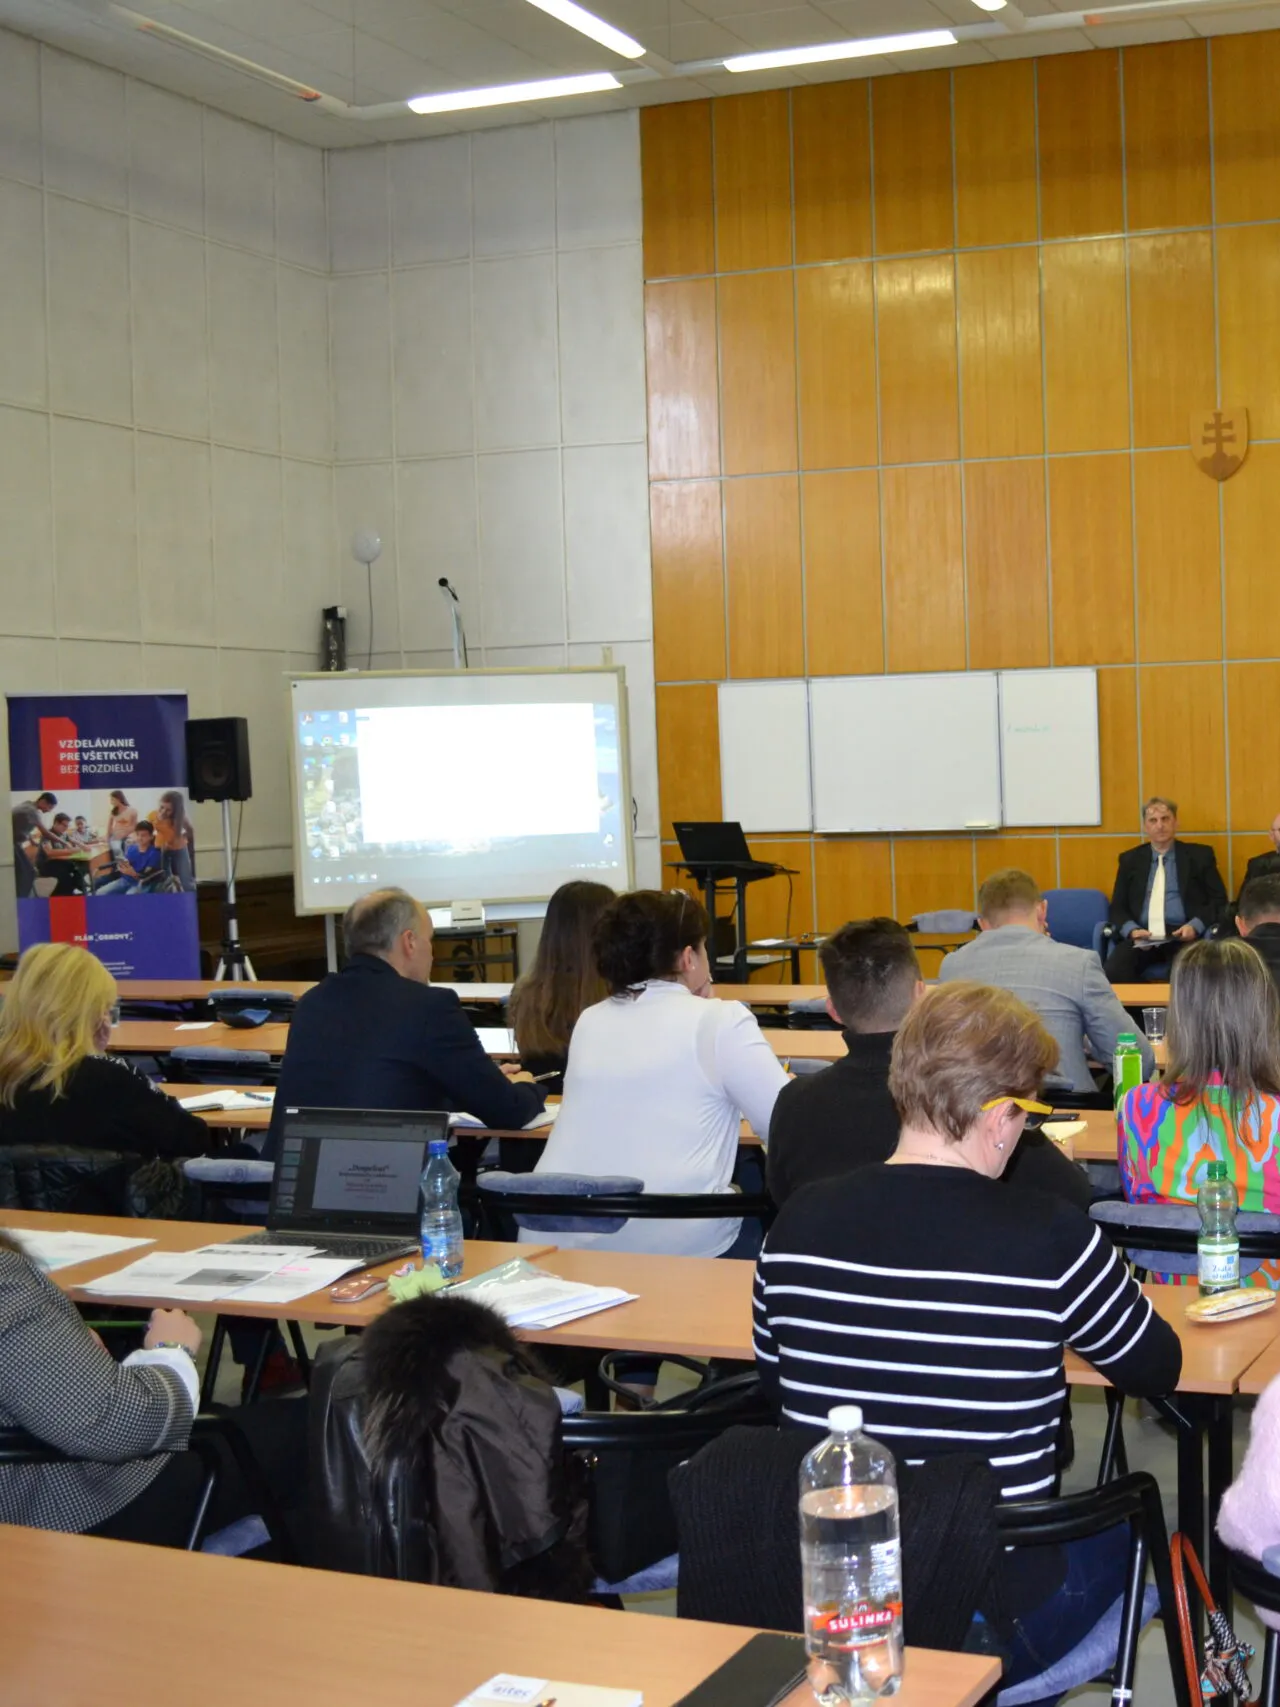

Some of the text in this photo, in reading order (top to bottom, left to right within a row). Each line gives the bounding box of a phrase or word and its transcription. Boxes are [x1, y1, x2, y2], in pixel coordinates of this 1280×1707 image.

[59, 738, 135, 748] VZDELÁVANIE
[60, 750, 139, 761] PRE VŠETKÝCH
[60, 763, 134, 774] BEZ ROZDIELU
[828, 1611, 893, 1633] SULINKA
